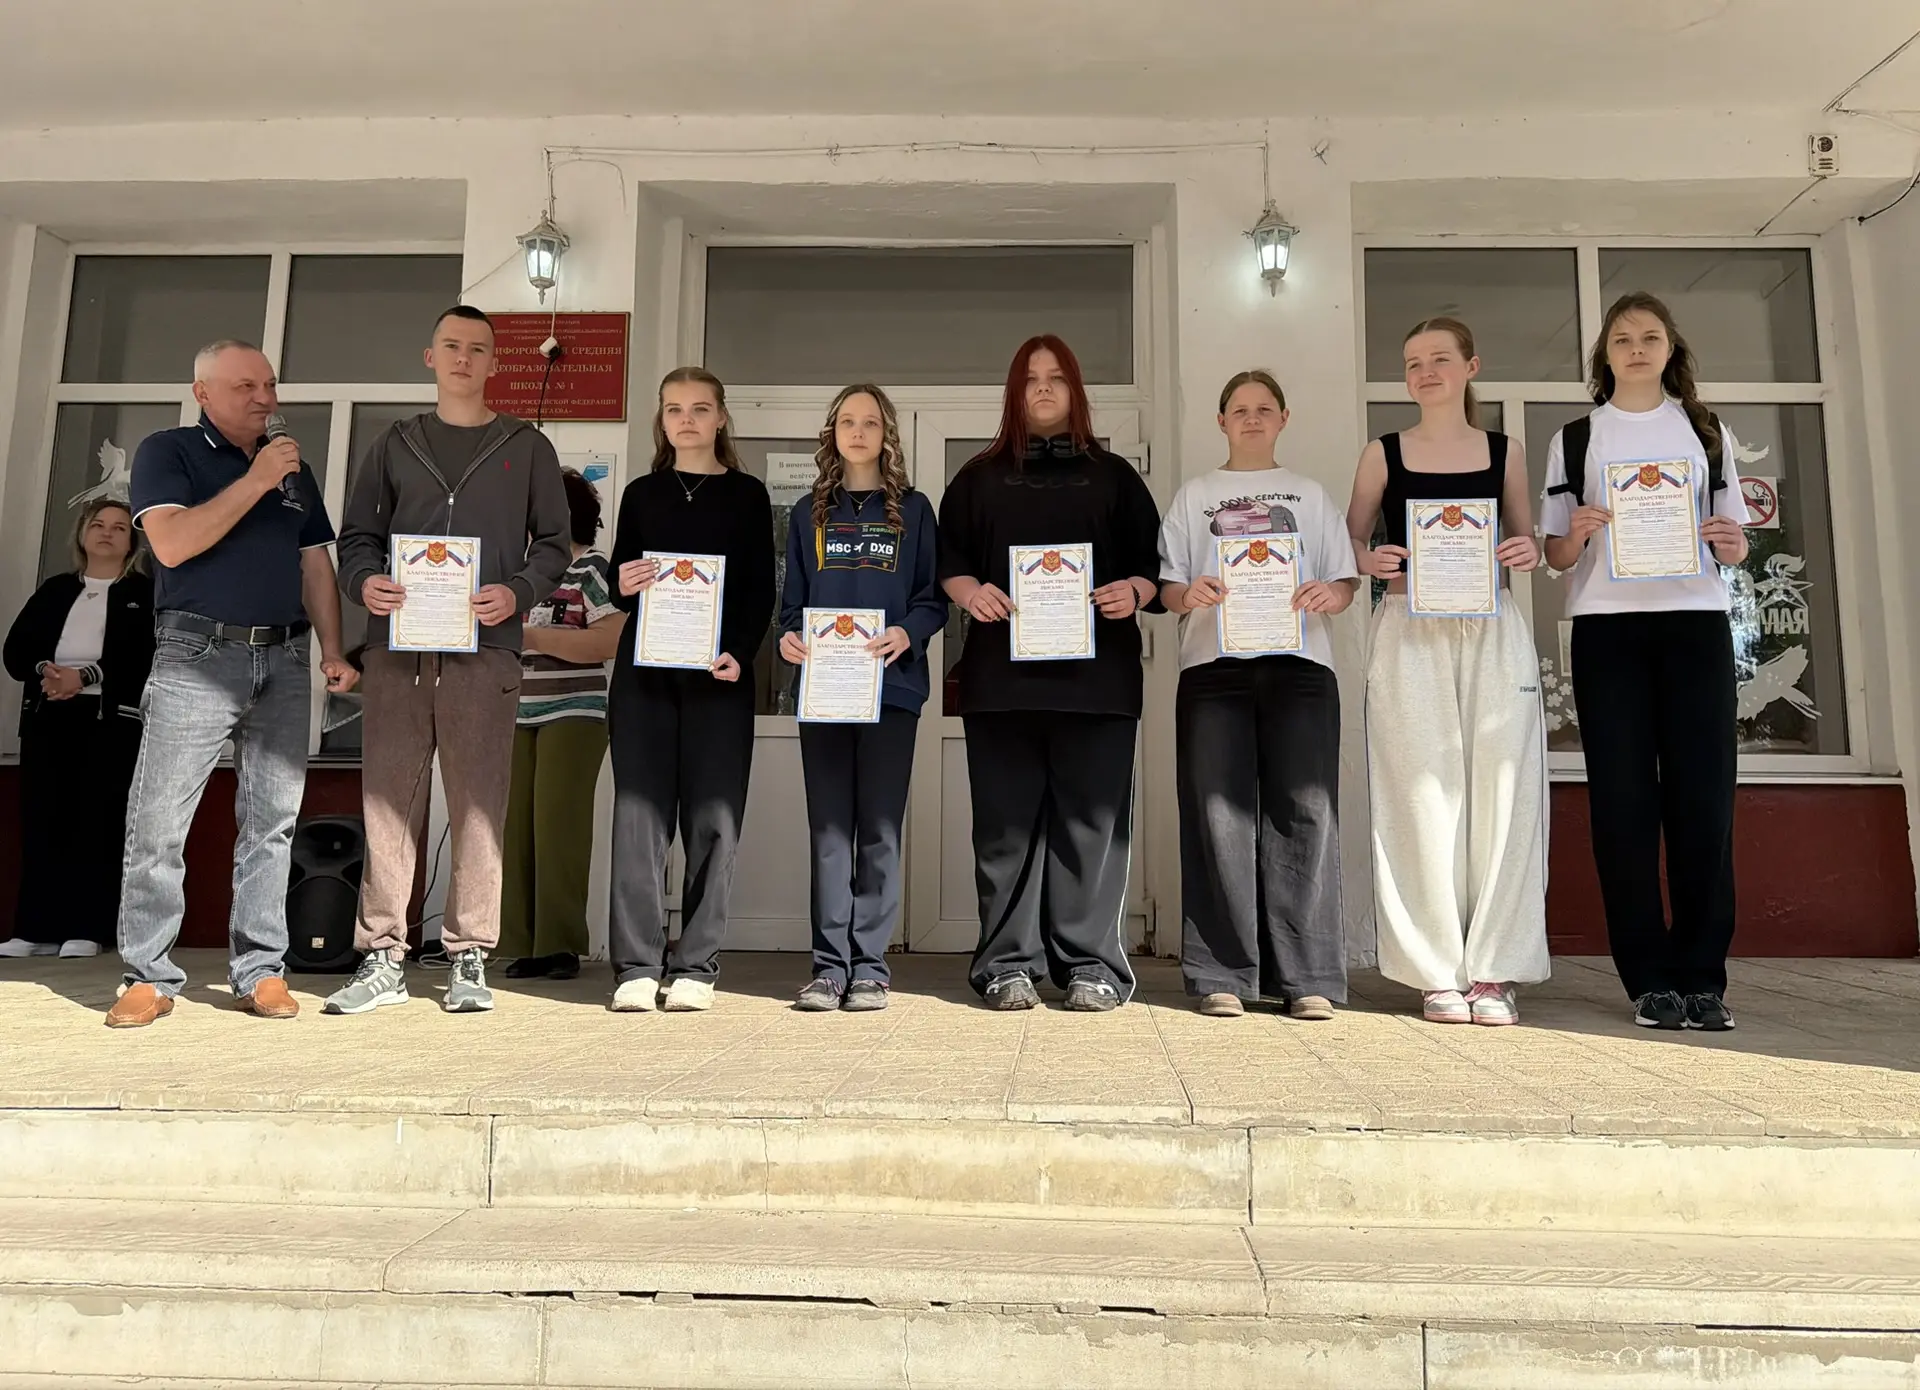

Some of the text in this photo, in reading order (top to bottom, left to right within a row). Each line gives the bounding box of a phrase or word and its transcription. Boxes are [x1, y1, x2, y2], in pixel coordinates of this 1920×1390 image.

[495, 346, 622, 356] ИФОРОВЯ СРЕДНЯЯ
[499, 363, 612, 373] ЕОБРАЗОВАТЕЛЬНАЯ
[510, 382, 550, 390] ШКОЛА
[1255, 492, 1302, 504] CENTURY
[826, 542, 894, 555] MSC DXB
